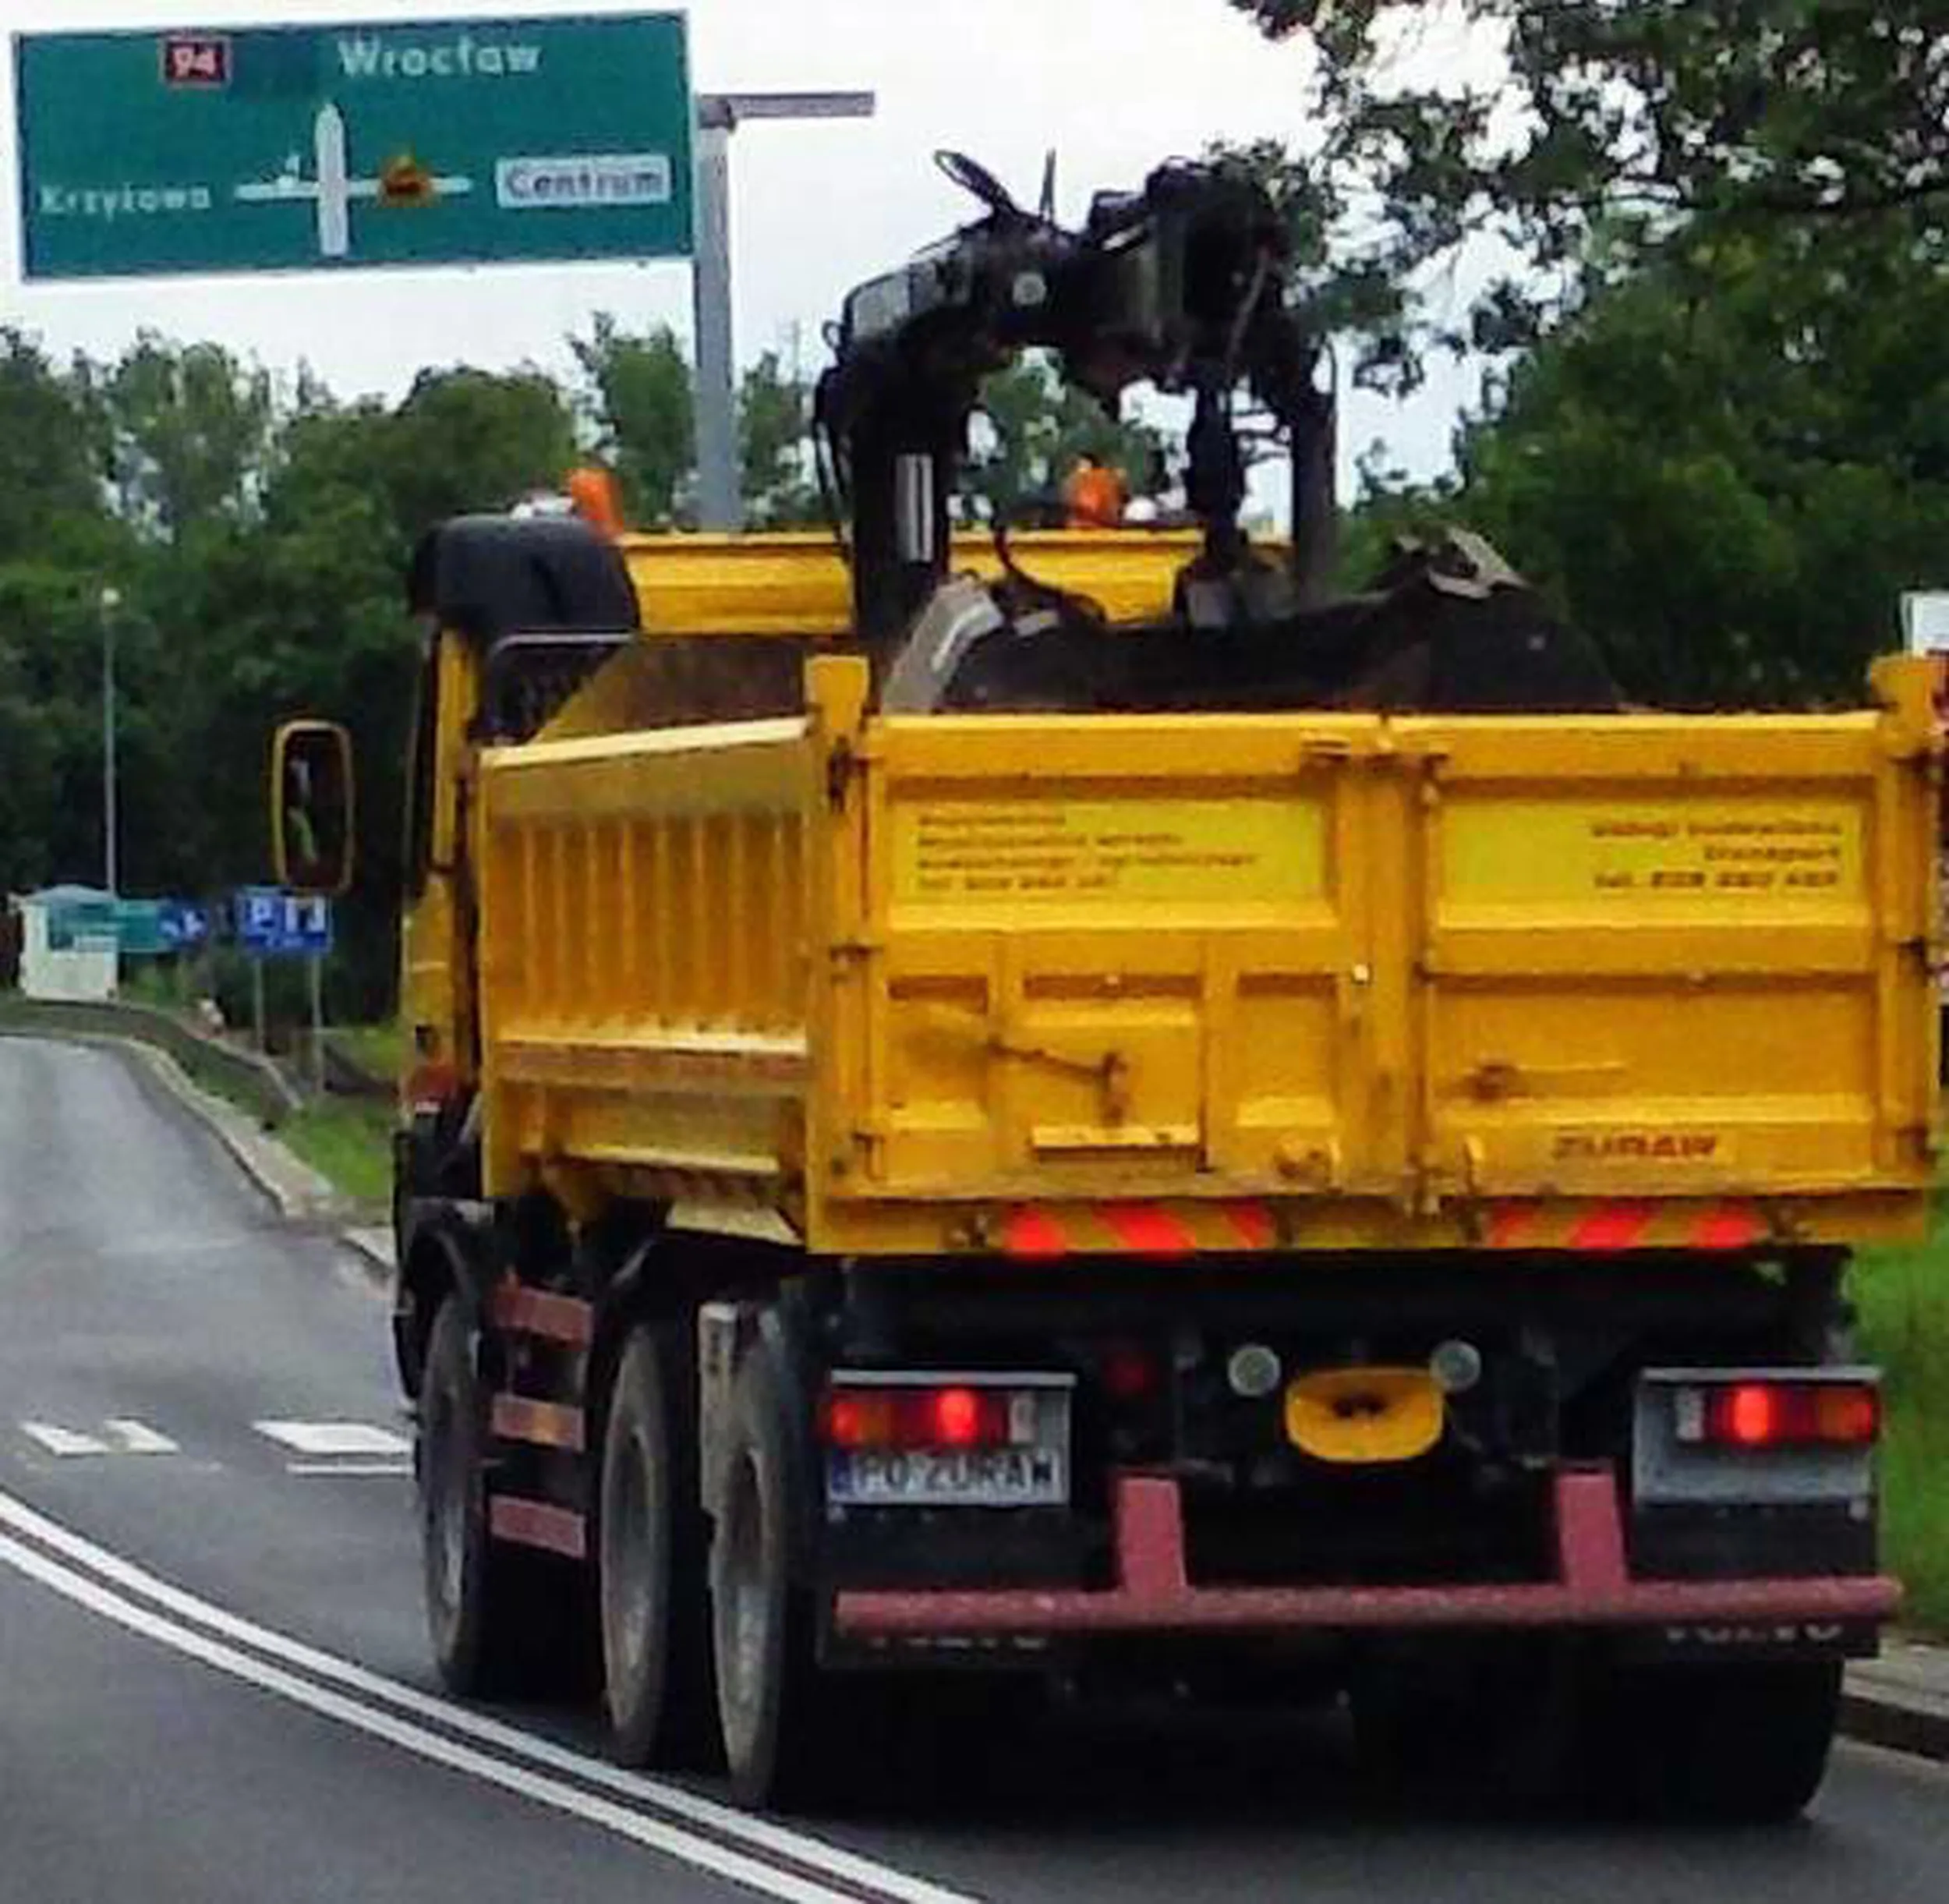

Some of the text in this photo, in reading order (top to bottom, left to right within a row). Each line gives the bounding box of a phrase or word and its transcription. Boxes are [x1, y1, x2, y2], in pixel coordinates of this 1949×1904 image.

[172, 46, 217, 79] 94
[338, 34, 542, 77] Wrocław
[506, 168, 662, 199] Centrum
